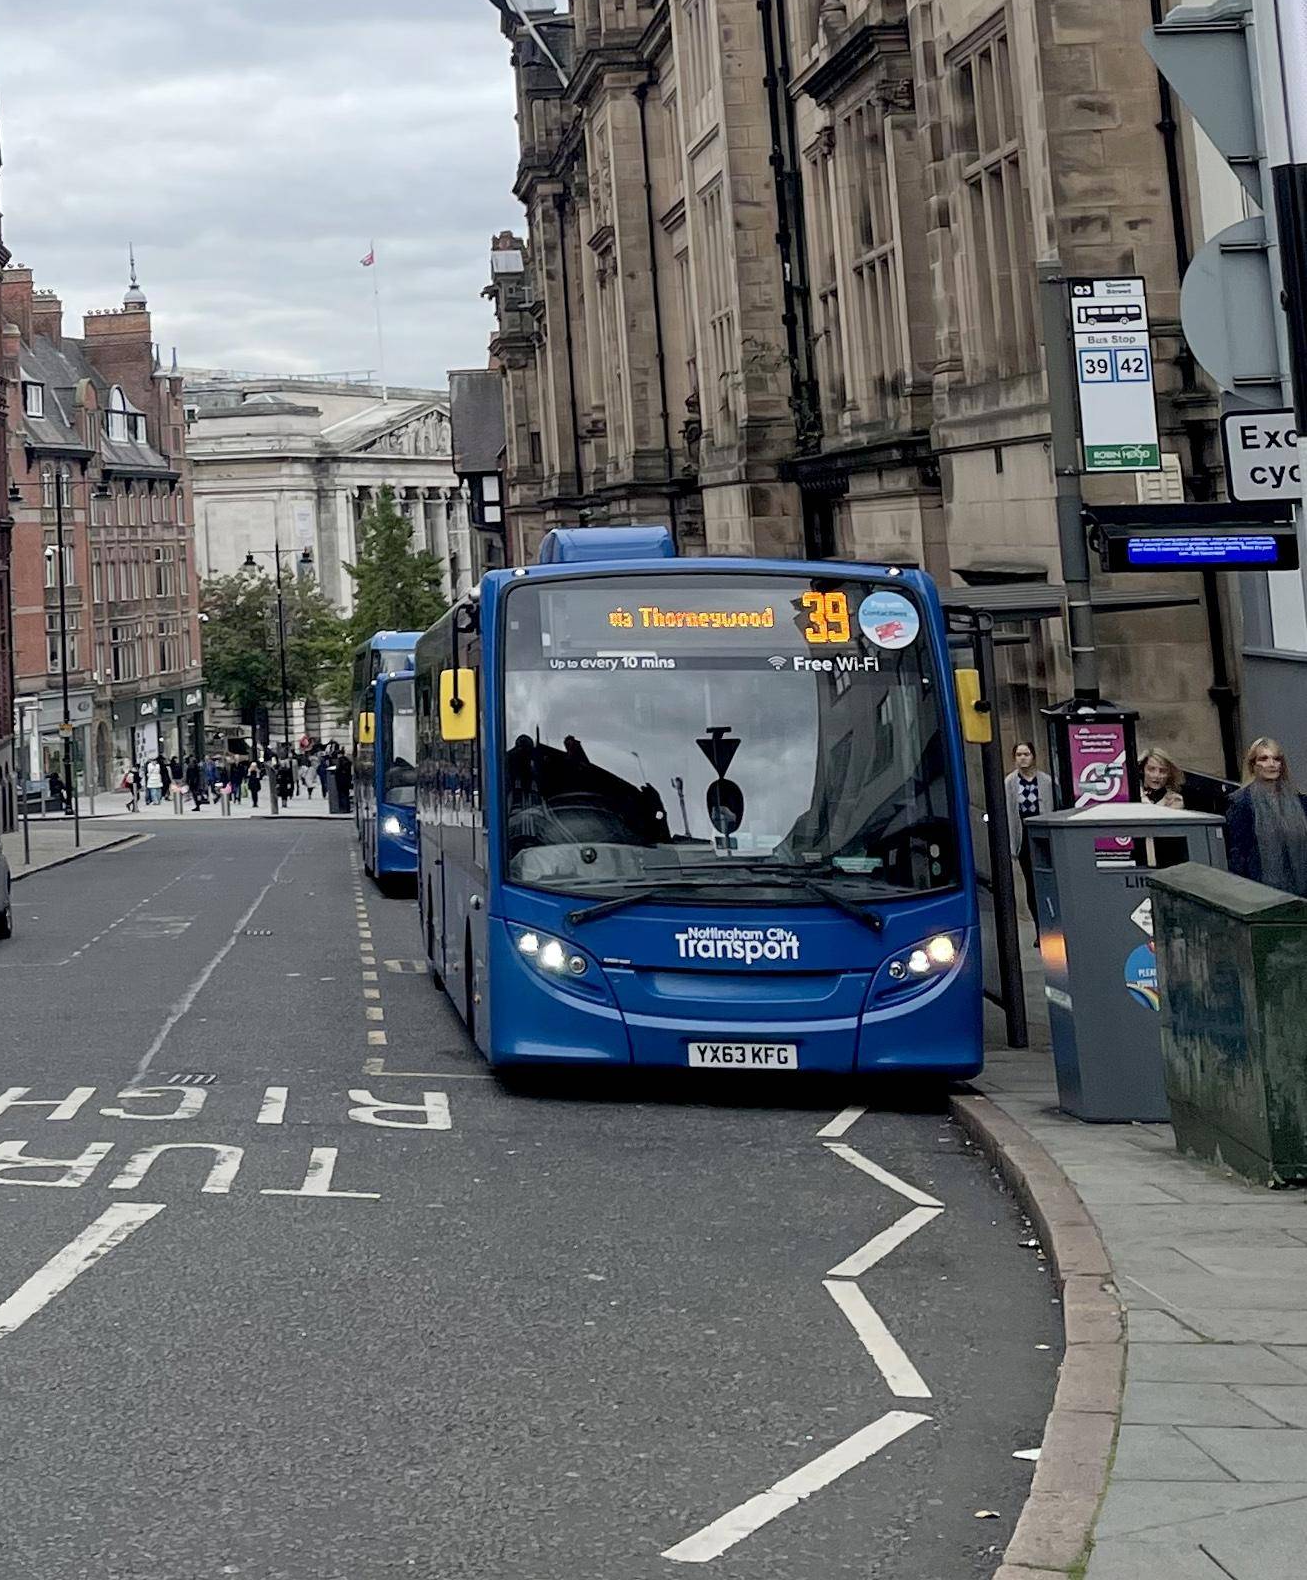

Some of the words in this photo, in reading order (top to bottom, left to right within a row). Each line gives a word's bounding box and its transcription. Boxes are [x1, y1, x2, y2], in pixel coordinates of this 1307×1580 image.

[1088, 336, 1108, 344] Bus
[1112, 335, 1136, 344] Stop
[1085, 359, 1108, 374] 39
[1121, 358, 1144, 373] 42
[638, 606, 774, 628] Thorneywood
[802, 591, 851, 643] 39
[550, 659, 565, 670] Up
[567, 659, 578, 668] to
[580, 657, 618, 671] every
[621, 656, 637, 669] 10
[641, 656, 675, 669] mins
[793, 656, 833, 671] Free
[837, 656, 880, 671] Wi-Fi
[688, 927, 763, 942] Nottingham
[767, 928, 794, 942] City
[675, 933, 800, 964] Transport
[697, 1045, 746, 1063] YX63
[751, 1046, 788, 1065] KFG
